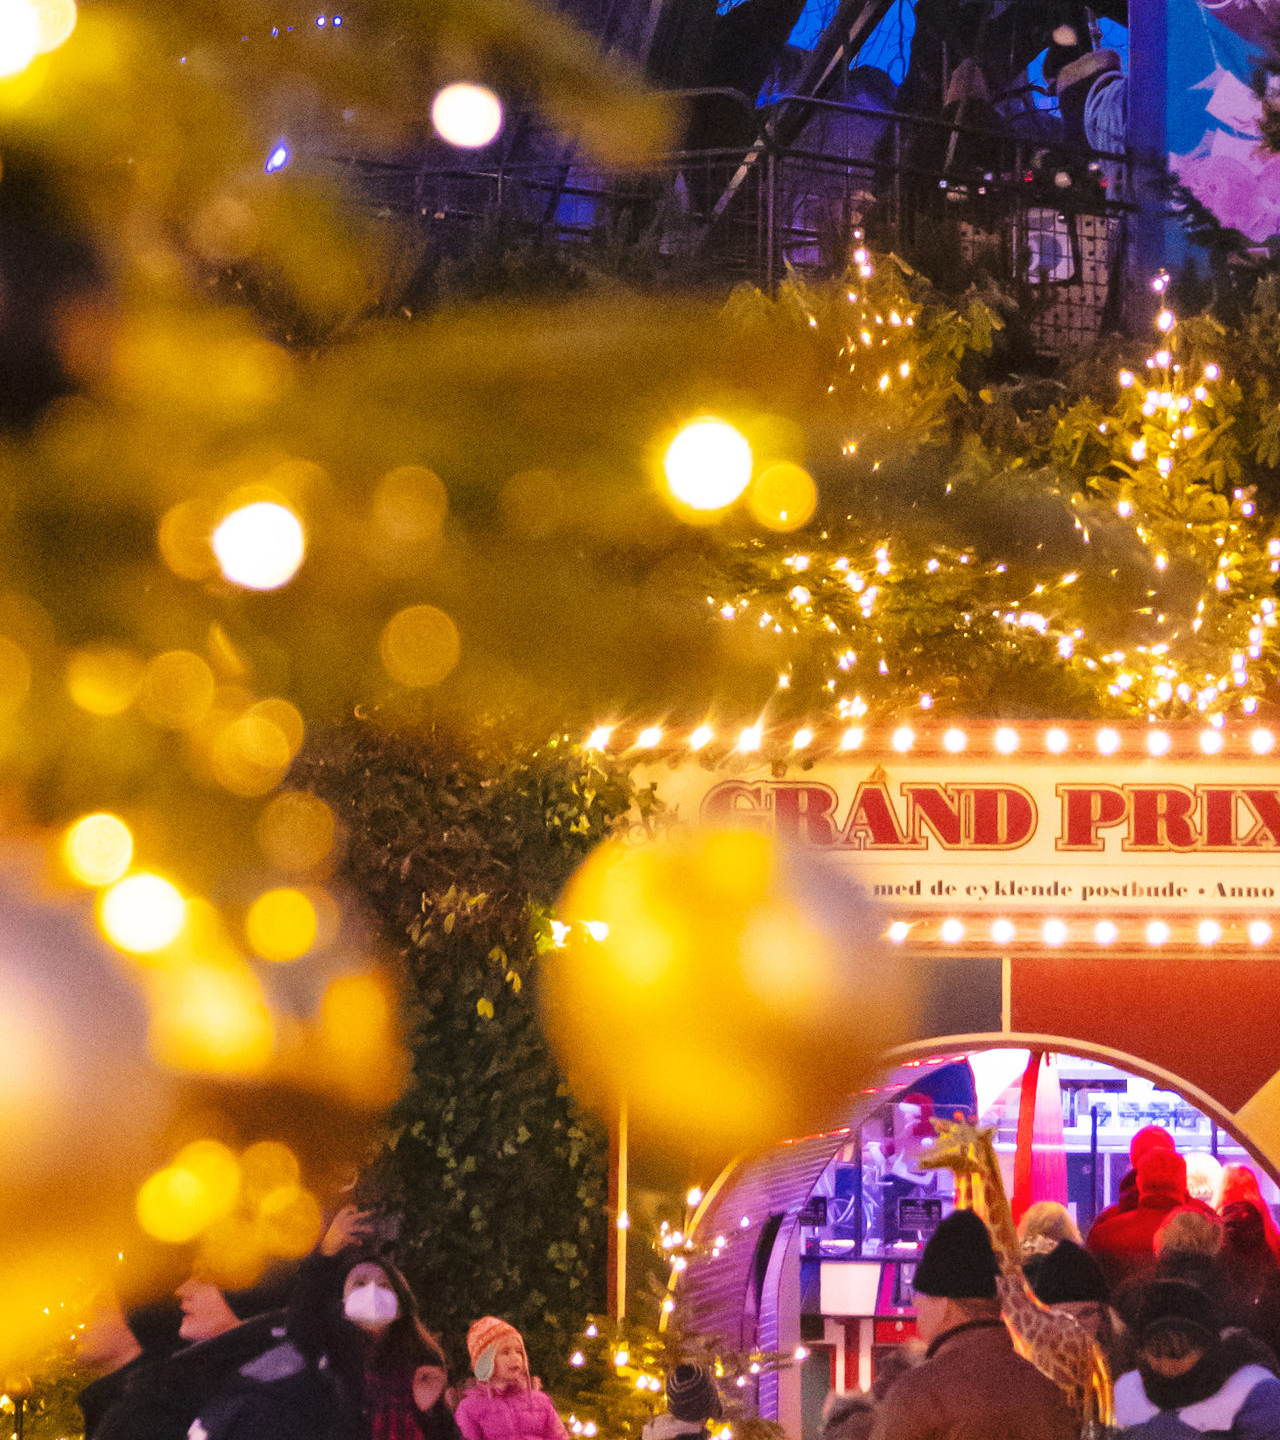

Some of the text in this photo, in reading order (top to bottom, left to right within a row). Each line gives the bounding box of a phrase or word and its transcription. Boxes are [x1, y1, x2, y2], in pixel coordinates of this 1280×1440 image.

[699, 779, 1039, 852] GRAND
[873, 880, 921, 896] med
[930, 880, 957, 896] de
[965, 880, 1073, 901] cyklende
[1081, 881, 1188, 901] postbude
[1211, 881, 1275, 898] Anno
